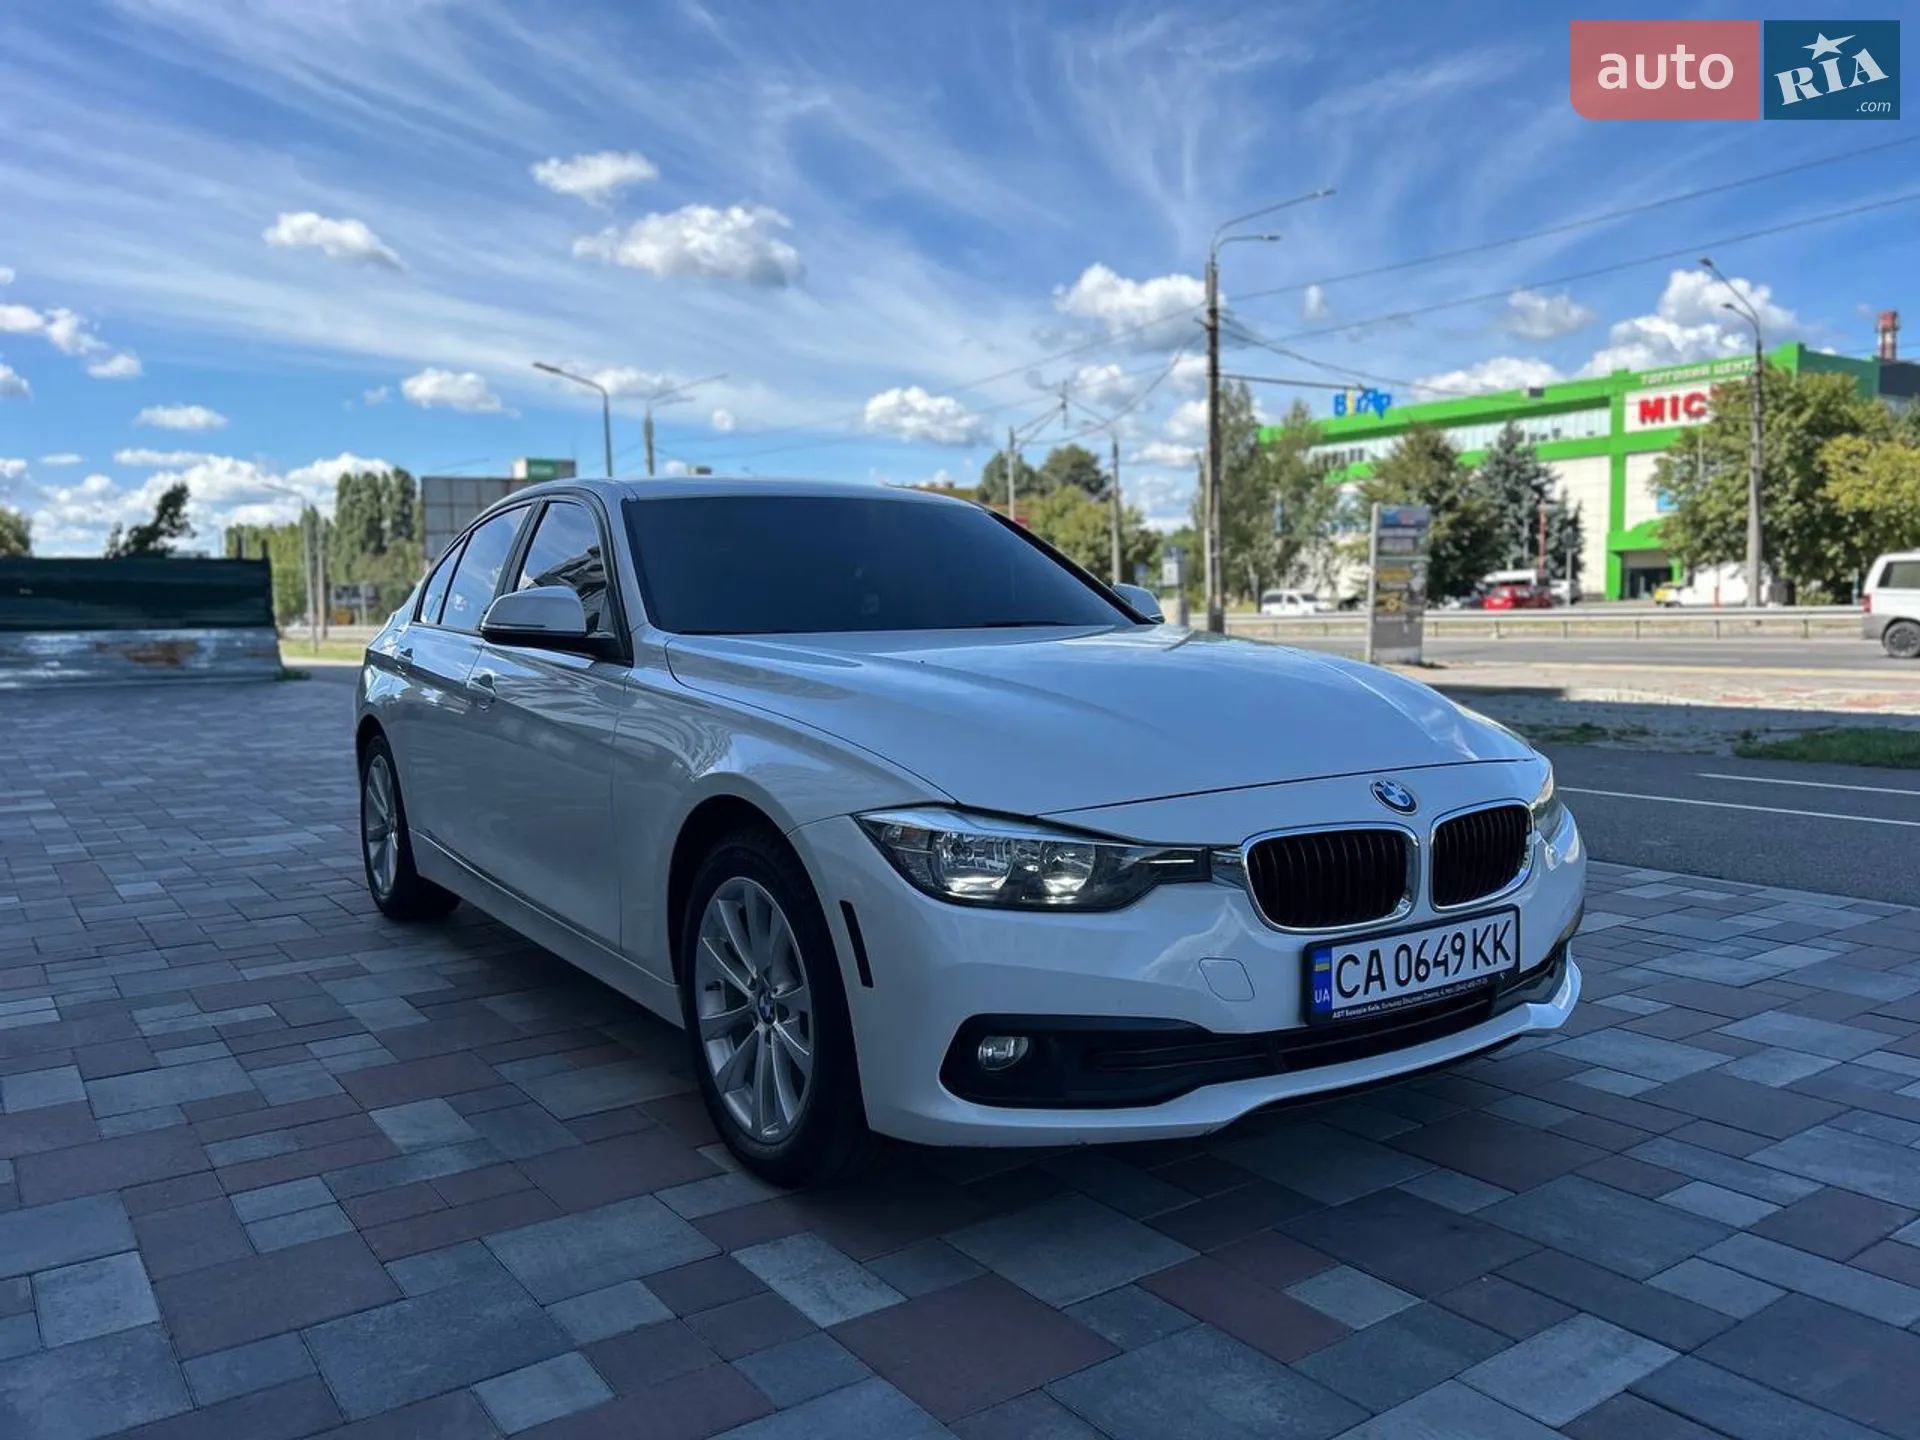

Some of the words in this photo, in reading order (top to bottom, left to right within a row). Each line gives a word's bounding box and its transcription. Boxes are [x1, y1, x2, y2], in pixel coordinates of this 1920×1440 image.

[1639, 384, 1723, 424] МІС
[1336, 949, 1387, 999] CA
[1395, 931, 1465, 987] 0649
[1472, 919, 1512, 970] KK
[1315, 988, 1330, 1004] UA
